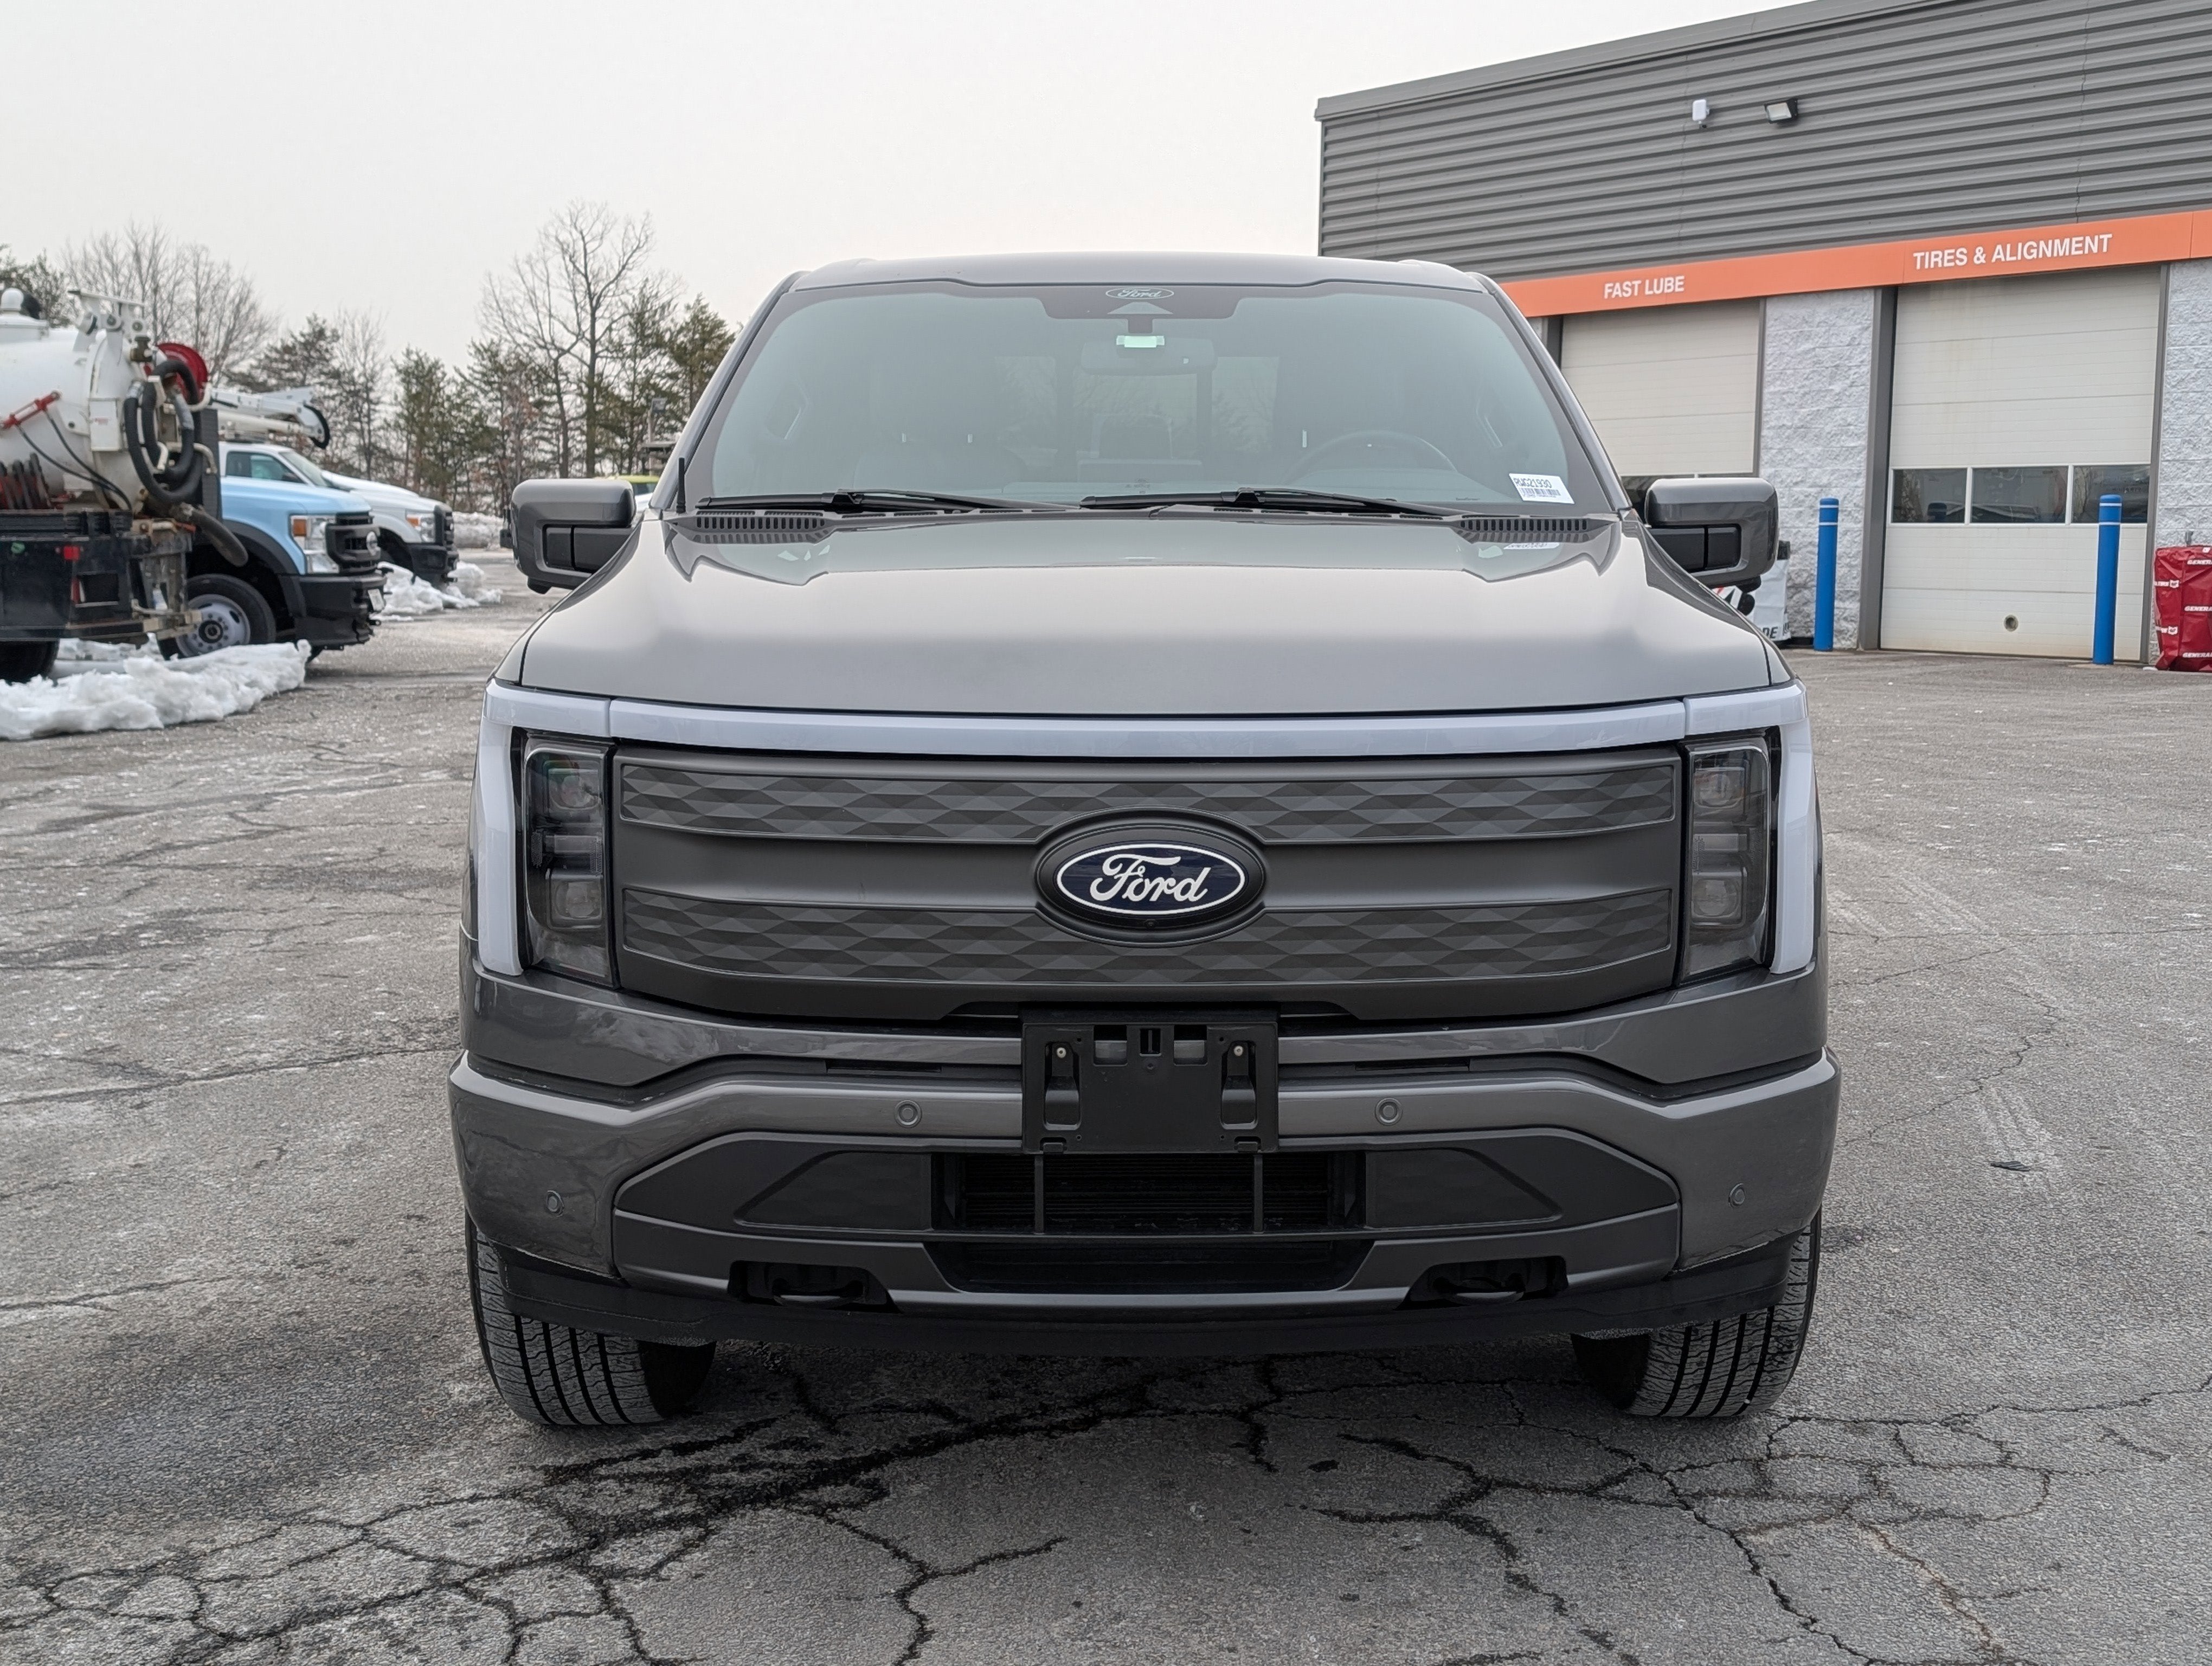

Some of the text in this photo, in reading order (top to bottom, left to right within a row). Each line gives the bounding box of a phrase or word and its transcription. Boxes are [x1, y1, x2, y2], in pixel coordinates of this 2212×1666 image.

[1913, 233, 2113, 270] TIRES & ALIGNMENT
[1117, 289, 1162, 298] Ford
[1604, 275, 1685, 299] FAST LUBE
[1090, 854, 1211, 901] Ford
